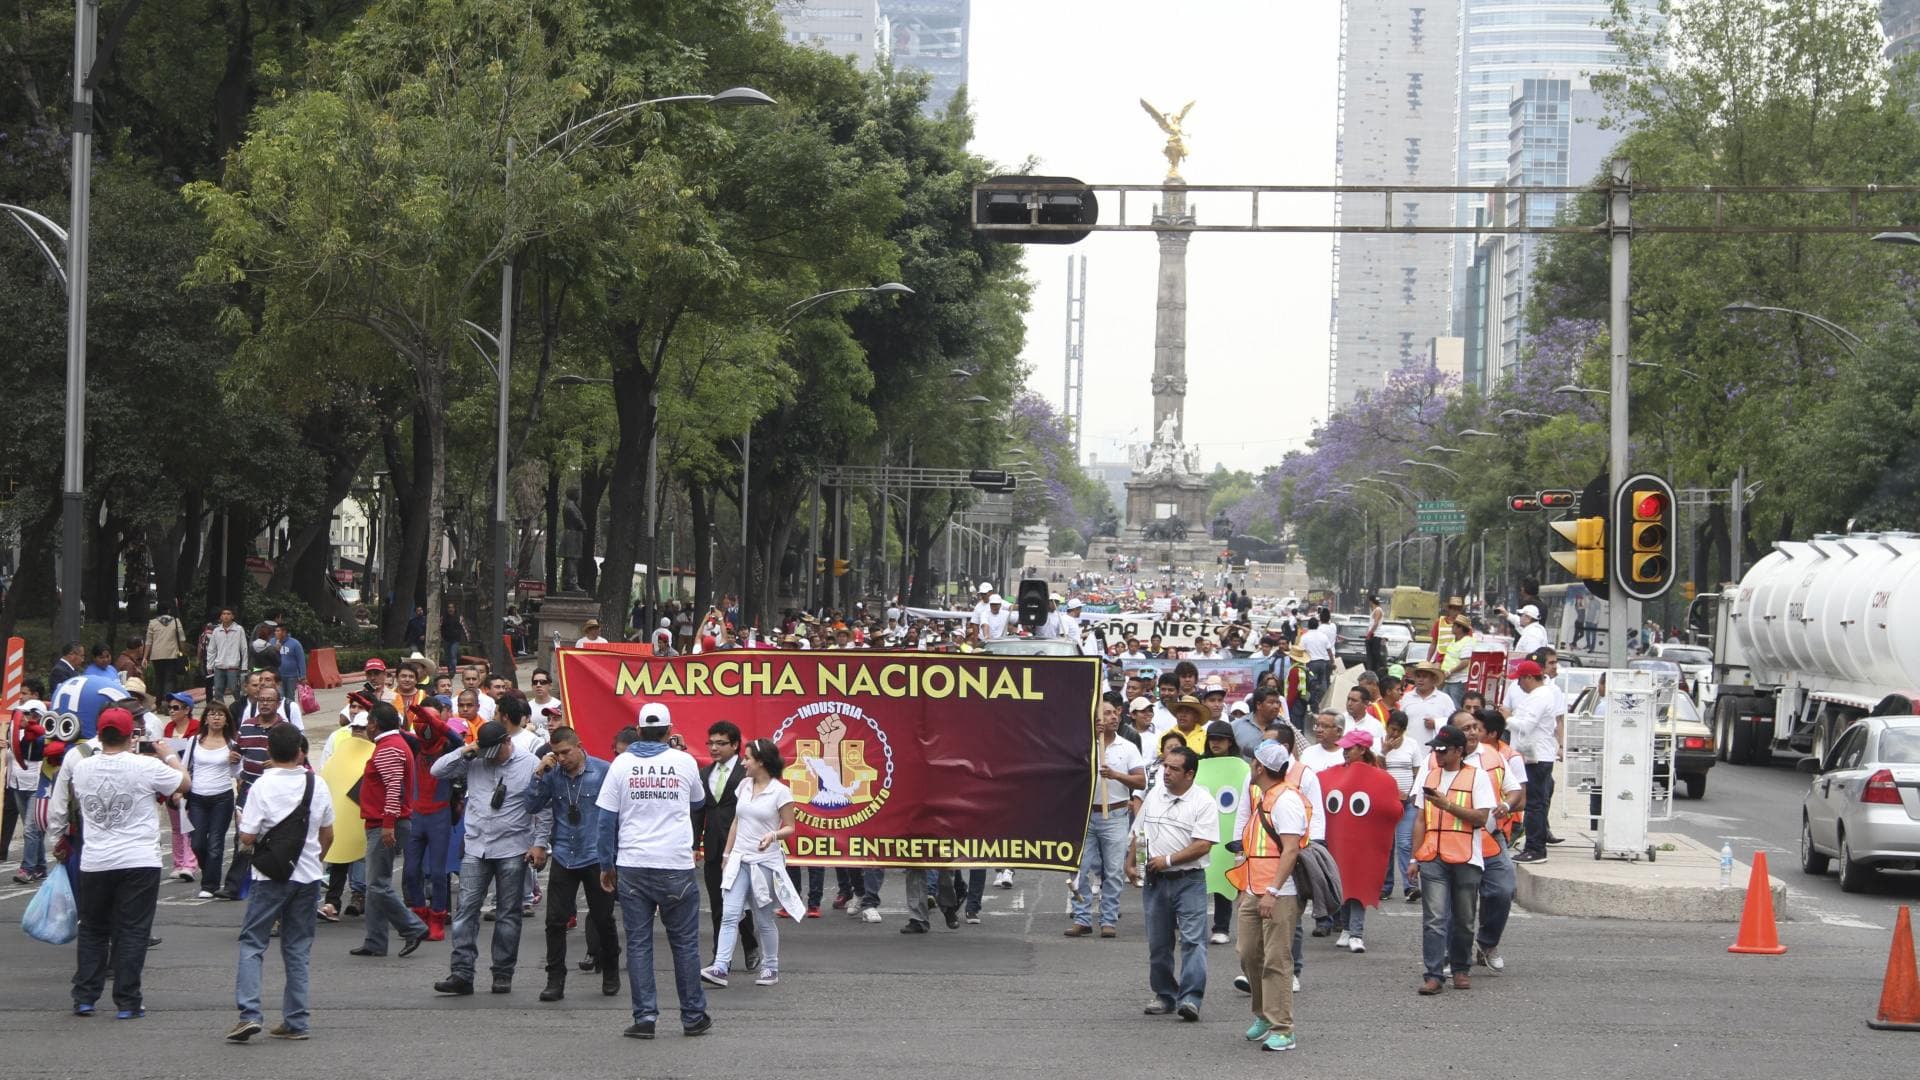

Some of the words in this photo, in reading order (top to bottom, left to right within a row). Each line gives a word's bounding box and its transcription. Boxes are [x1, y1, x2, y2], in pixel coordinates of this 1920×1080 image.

[615, 661, 804, 697] MARCHA
[816, 662, 1045, 701] NACIONAL
[797, 701, 863, 720] INDUSTRIA
[632, 766, 644, 775] SI
[648, 766, 657, 775] A
[660, 766, 676, 775] LA
[629, 777, 679, 788] REGULACION
[630, 791, 679, 800] GOBERNACION
[797, 836, 841, 857] DEL
[849, 837, 1074, 862] ENTRETENIMIENTO
